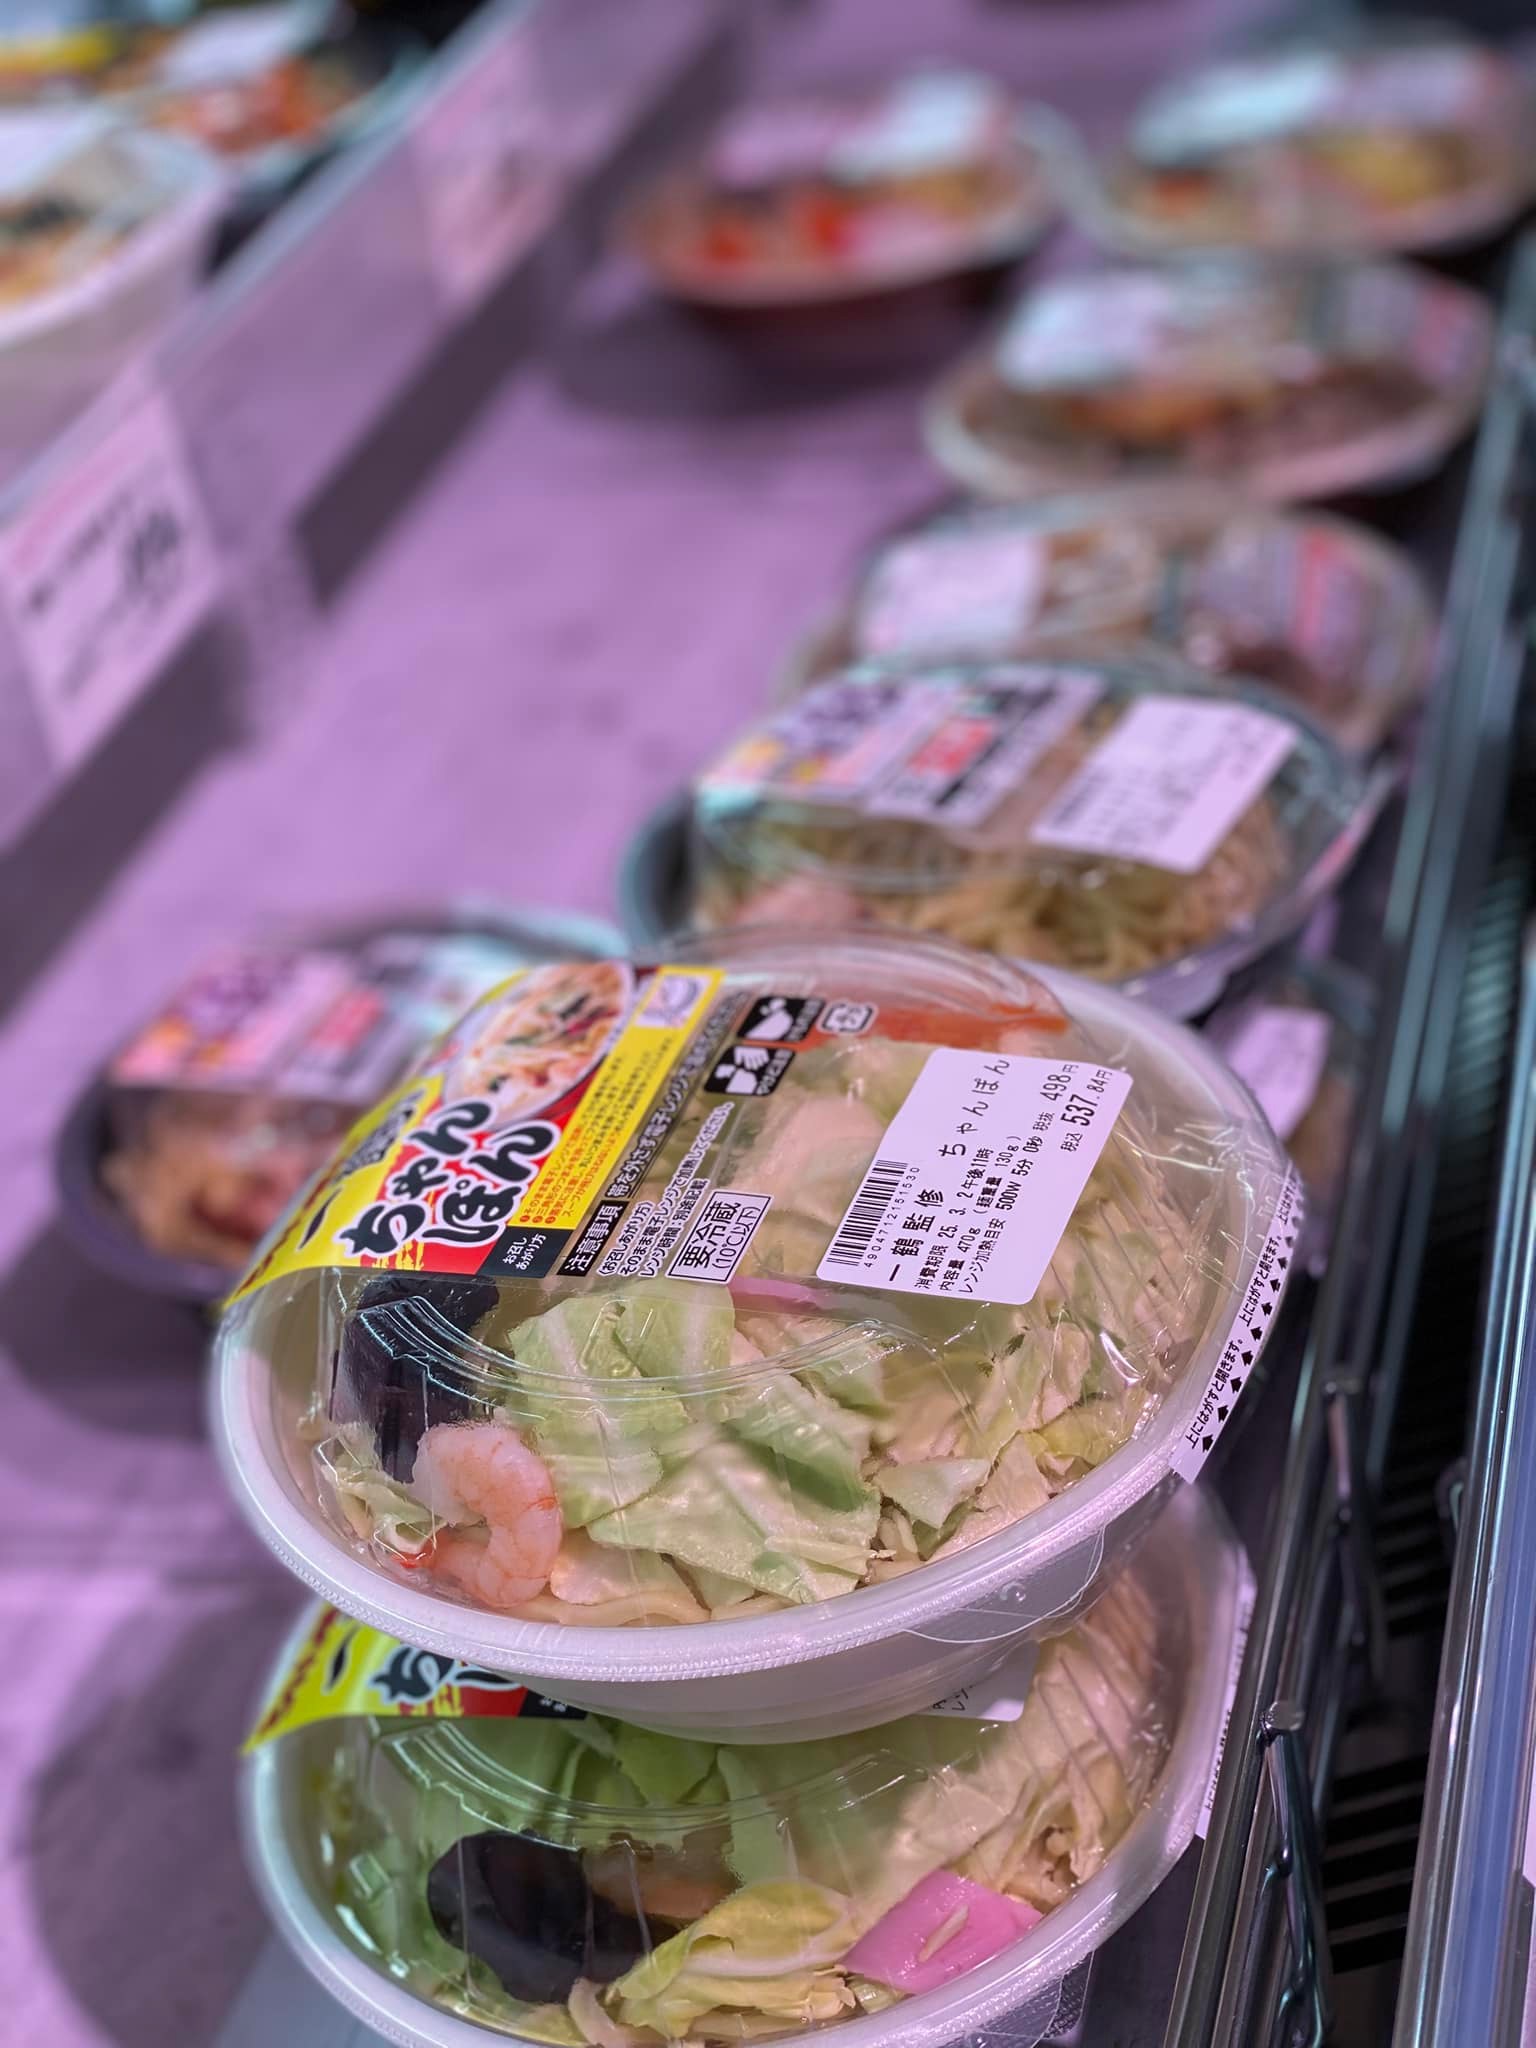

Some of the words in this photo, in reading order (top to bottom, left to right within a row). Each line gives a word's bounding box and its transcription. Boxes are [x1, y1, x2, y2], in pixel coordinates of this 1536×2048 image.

[1033, 1112, 1054, 1131] 税抜
[1061, 1133, 1082, 1152] 税込
[340, 1102, 491, 1254] ちゃん
[421, 1126, 555, 1243] ぽん
[889, 1189, 943, 1281] 一鶴監修
[938, 1060, 1009, 1156] ちゃんぽん
[567, 1204, 623, 1272] 注意事項
[680, 1201, 741, 1269] 要冷蔵
[864, 1168, 919, 1267] 4904712151530
[959, 1218, 1006, 1293] レンジ加熱目安
[995, 1181, 1021, 1210] 500W
[1012, 1159, 1033, 1176] 5分
[1023, 1136, 1043, 1152] 0秒
[503, 1237, 528, 1266] お召し
[516, 1233, 547, 1270] あがり方
[914, 1245, 948, 1289] 消費期限
[939, 1260, 965, 1290] 内容量
[1239, 1235, 1283, 1328] 上にはがすと開きます。
[1186, 1338, 1245, 1449] 上にはがすと開きます。
